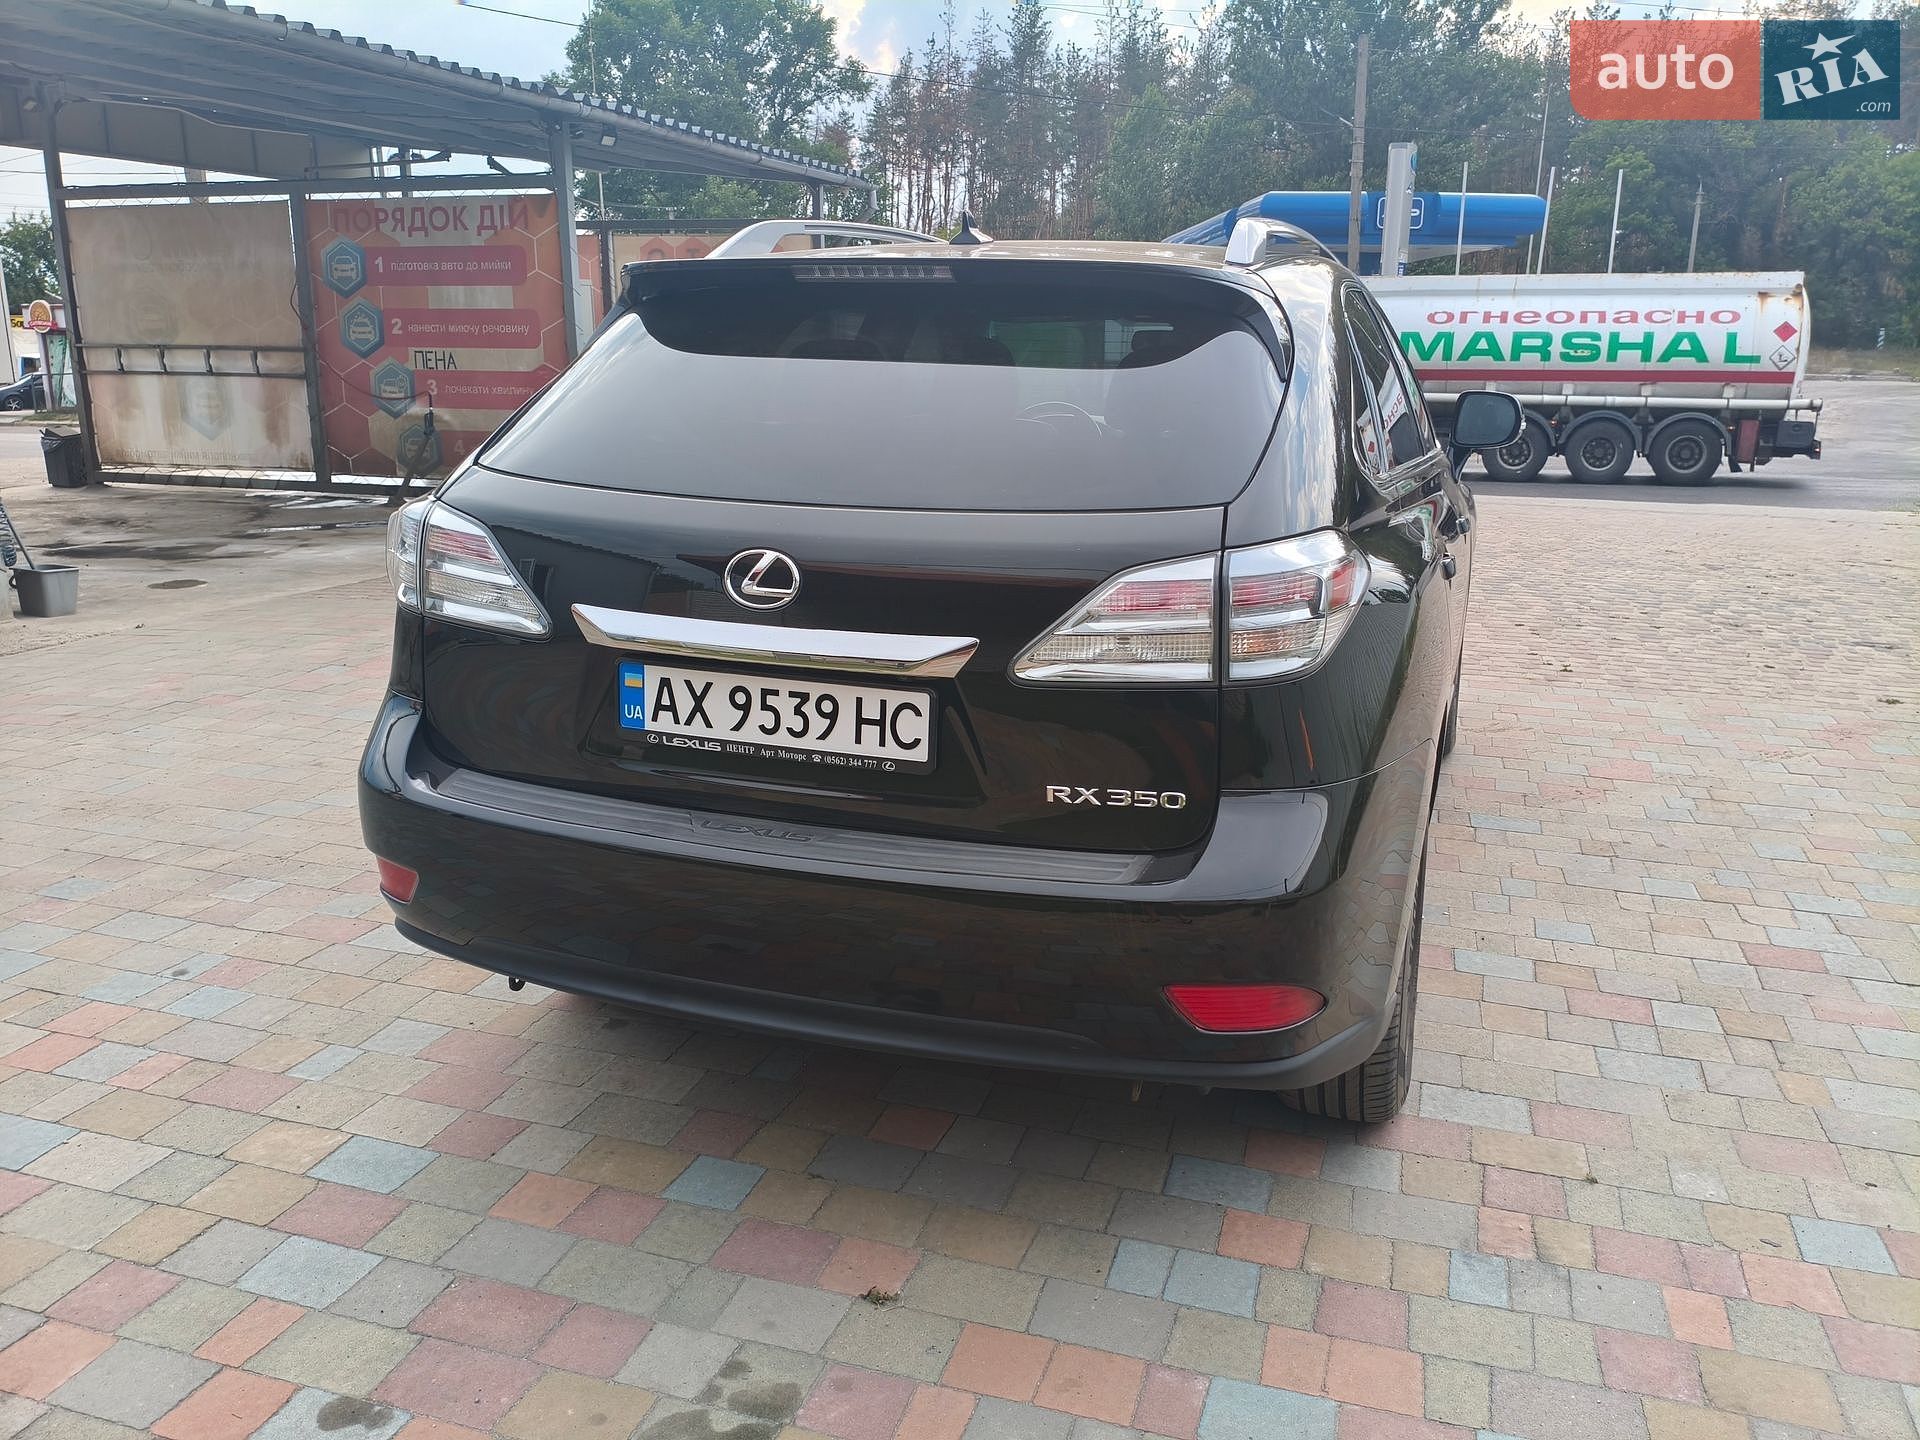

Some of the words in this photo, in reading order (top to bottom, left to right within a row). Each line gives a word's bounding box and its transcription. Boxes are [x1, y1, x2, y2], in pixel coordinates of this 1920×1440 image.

[333, 205, 469, 238] ПОРЯДОК
[476, 197, 530, 236] ДІЙ
[375, 256, 383, 272] 1
[441, 261, 464, 271] авто
[466, 261, 479, 273] до
[480, 259, 512, 271] мийки
[1426, 309, 1742, 325] огнеопасно
[391, 318, 402, 335] 2
[407, 323, 446, 333] нанести
[482, 323, 529, 336] речовину
[413, 350, 458, 370] ПЕНА
[427, 379, 438, 395] 3
[624, 703, 643, 720] UA
[650, 676, 714, 729] AX
[728, 685, 840, 741] 9539
[854, 696, 923, 750] HC
[662, 735, 722, 751] LEXUS
[726, 743, 755, 754] ЦЕНТР
[760, 748, 775, 758] Арт
[778, 749, 807, 762] Моторс
[824, 755, 847, 766] (0562)
[849, 758, 862, 767] 344
[864, 759, 878, 769] 777
[1046, 785, 1102, 806] RX
[1106, 788, 1187, 810] 350
